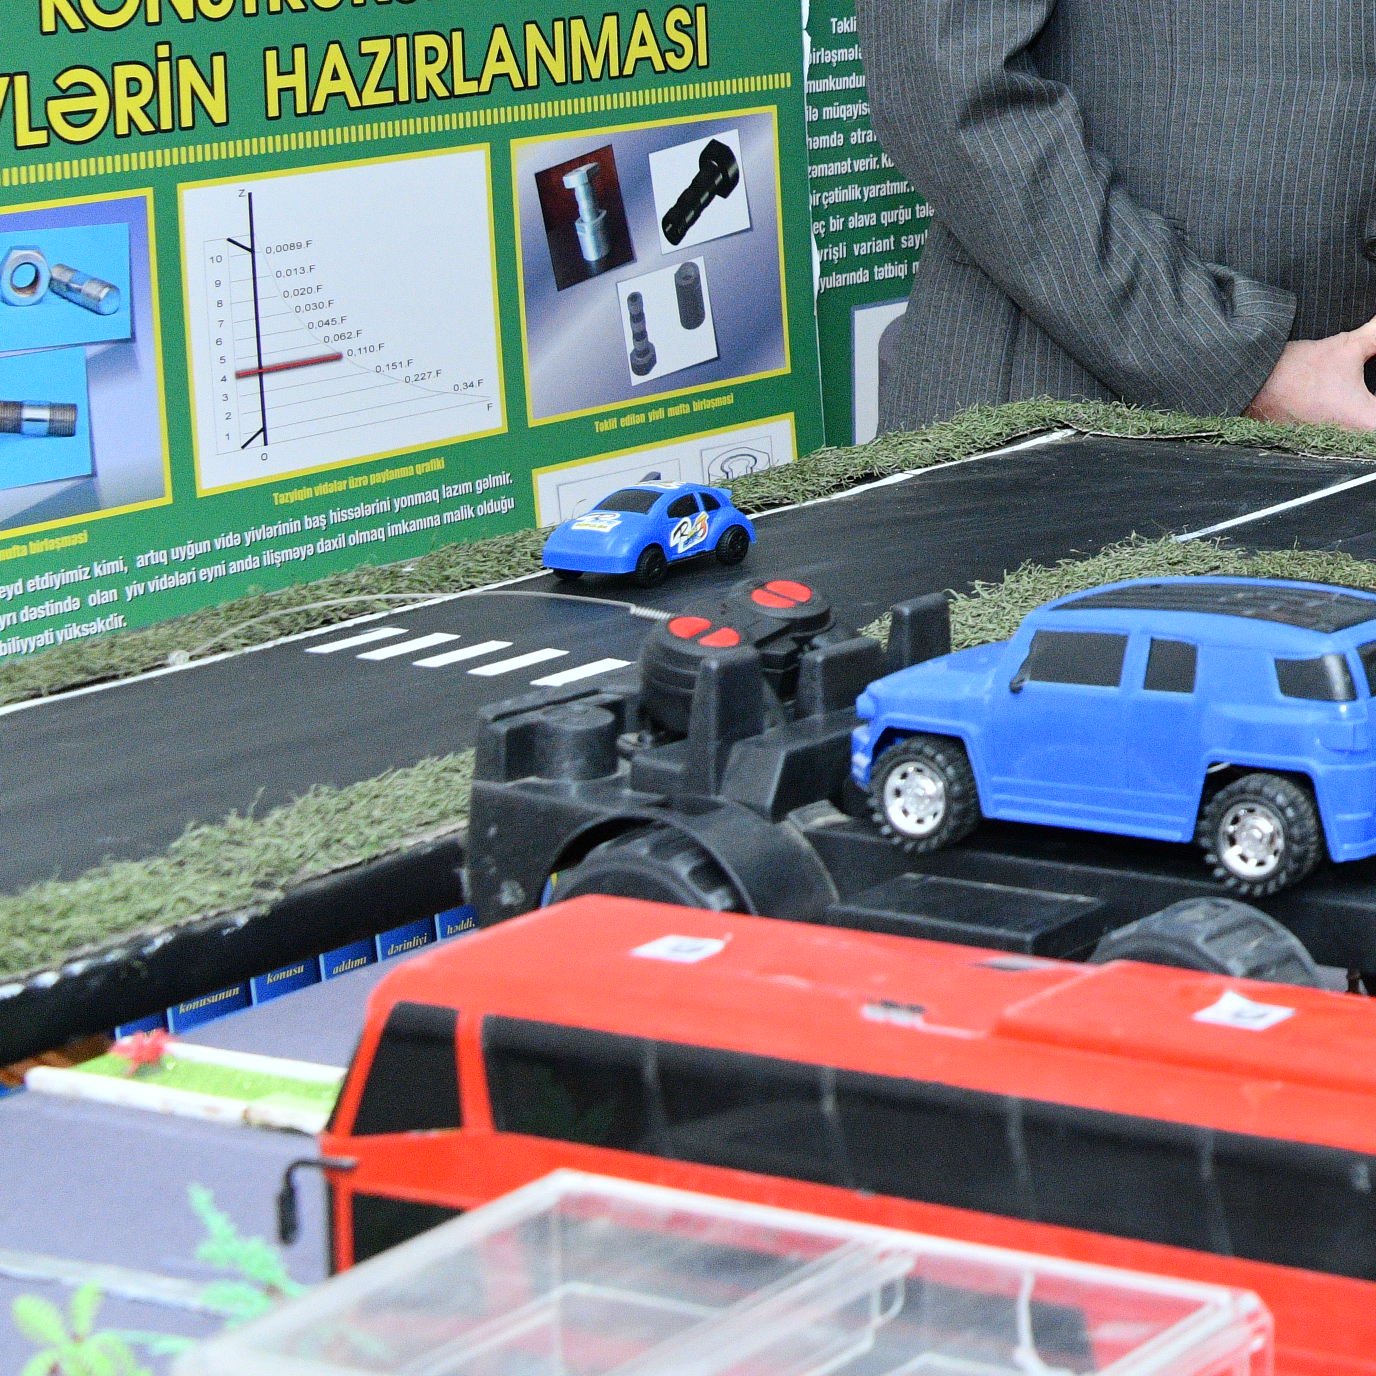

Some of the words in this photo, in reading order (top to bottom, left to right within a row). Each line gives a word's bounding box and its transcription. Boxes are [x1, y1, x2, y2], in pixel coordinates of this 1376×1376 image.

[831, 16, 857, 34] Təkli
[262, 3, 709, 120] HAZIRLANMASI
[853, 154, 879, 173] verir.
[823, 184, 862, 209] çətinlik
[829, 215, 845, 233] bir
[880, 205, 912, 227] qurğu
[915, 202, 935, 218] tələ
[853, 235, 895, 257] variant
[209, 254, 223, 265] 10
[214, 278, 222, 288] 9
[818, 267, 869, 294] yularında
[873, 260, 908, 281] tətbiqi
[216, 298, 224, 309] 8
[218, 319, 225, 328] 7
[215, 336, 223, 347] 6
[219, 355, 227, 365] 5
[220, 374, 228, 383] 4
[222, 393, 229, 402] 3
[487, 402, 494, 411] F
[225, 411, 232, 421] 2
[0, 579, 24, 601] eyd
[26, 565, 91, 593] etdiyimiz
[94, 556, 129, 578] kimi,
[171, 539, 211, 564] uyğun
[214, 531, 241, 551] vidə
[243, 517, 302, 546] yivlərinin
[304, 513, 328, 532] baş
[329, 496, 391, 524] hissələrini
[393, 488, 440, 515] yonmaq
[442, 481, 473, 500] lazım
[475, 471, 513, 494] gəlmir.
[88, 587, 118, 607] olan
[125, 582, 145, 603] yiv
[147, 568, 196, 593] vidələri
[199, 562, 226, 583] eyni
[229, 554, 260, 575] anda
[316, 532, 346, 555] daxil
[348, 523, 386, 546] olmaq
[387, 514, 441, 538] imkanına
[443, 506, 475, 525] malik
[477, 495, 515, 517] olduğu
[0, 628, 54, 657] biliyyəti
[56, 612, 127, 645] yüksəkdir.
[266, 964, 305, 985] konusu
[179, 985, 240, 1015] konusunun
